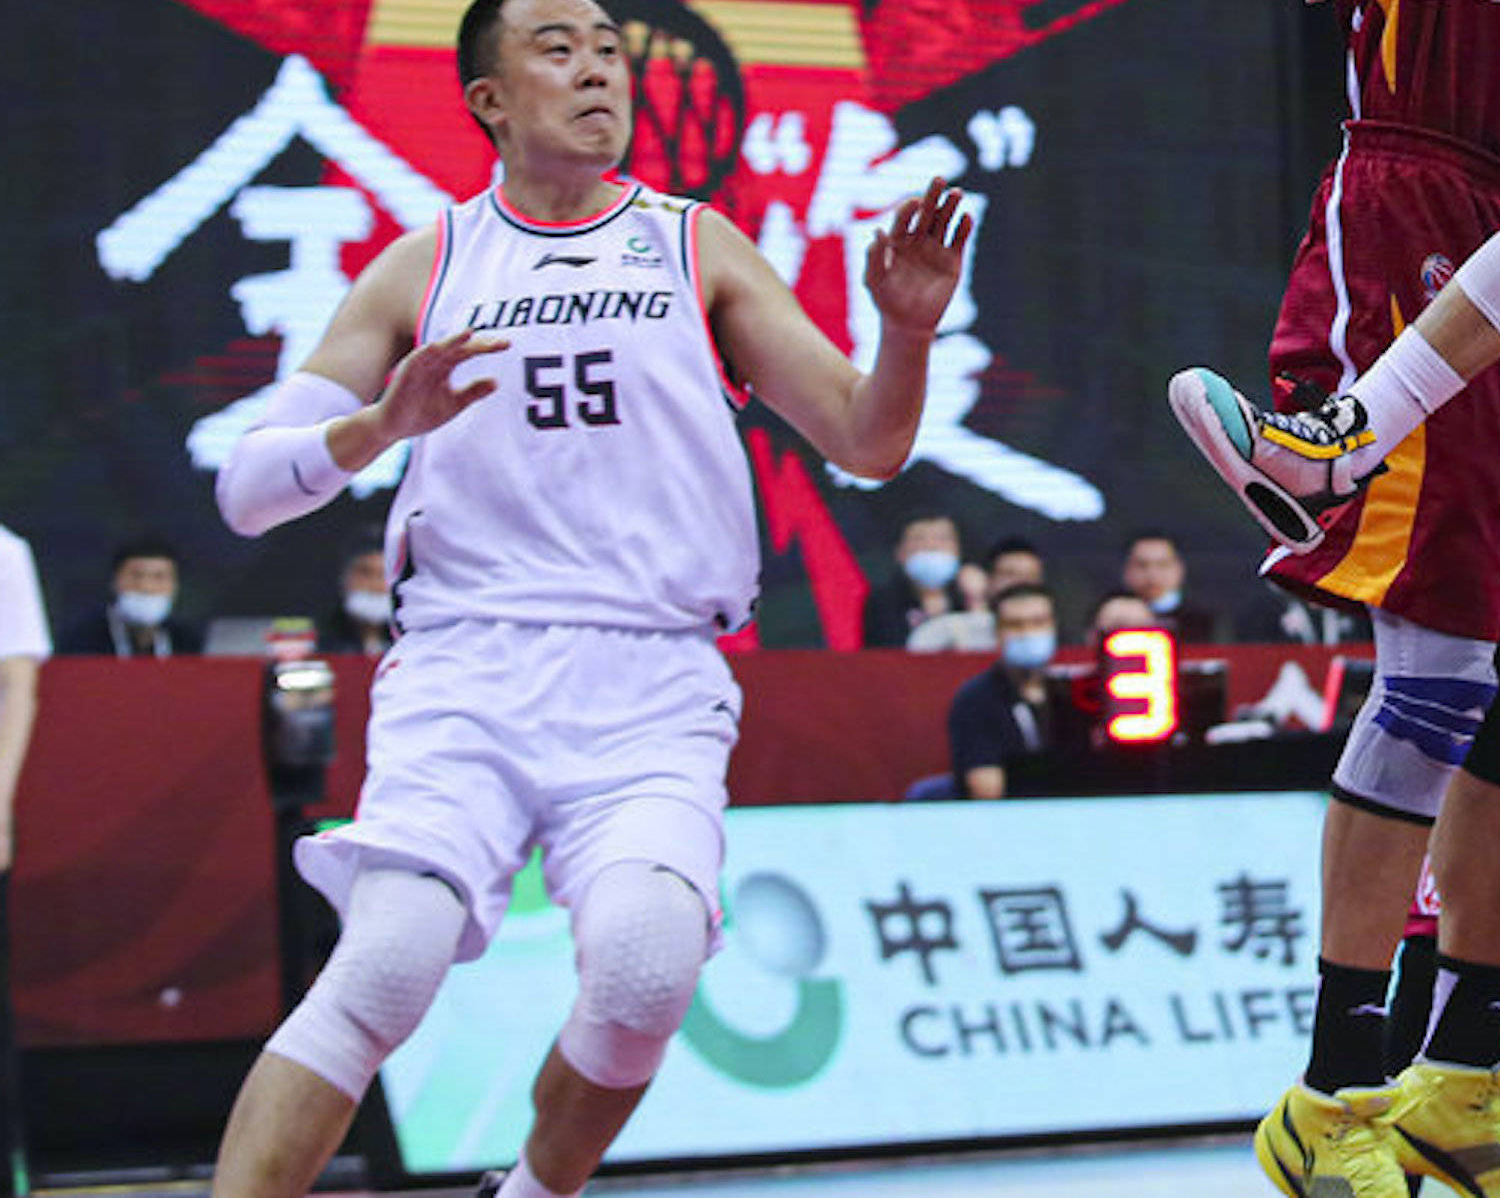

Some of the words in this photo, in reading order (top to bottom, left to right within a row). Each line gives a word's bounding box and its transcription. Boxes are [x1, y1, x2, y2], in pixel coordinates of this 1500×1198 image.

[467, 291, 675, 333] LIAONING
[522, 349, 622, 430] 55
[1104, 627, 1178, 743] 3
[865, 872, 1308, 985] 中国人寿
[898, 1001, 1153, 1059] CHINA
[1169, 986, 1317, 1044] LIFE
